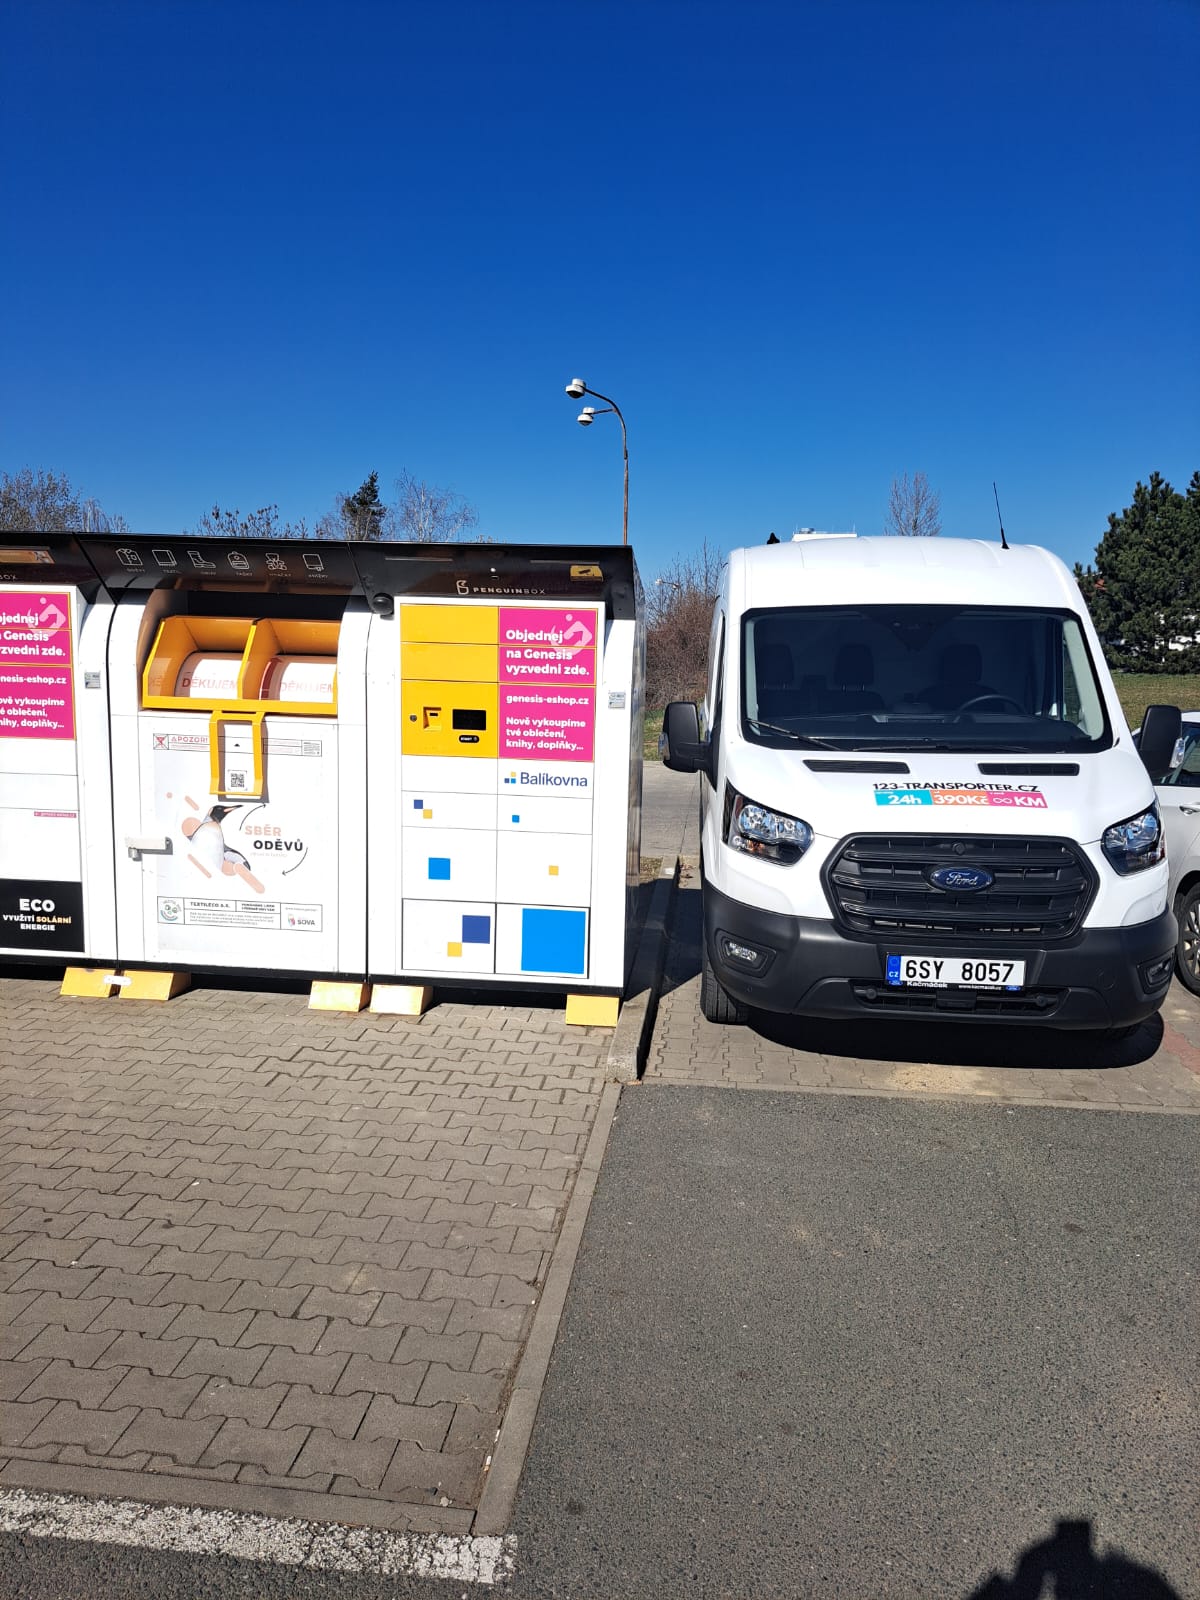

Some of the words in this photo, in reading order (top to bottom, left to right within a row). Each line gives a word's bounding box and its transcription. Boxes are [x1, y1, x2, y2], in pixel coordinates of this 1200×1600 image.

[473, 587, 546, 595] PENGUINBOX
[4, 630, 50, 643] Genesis
[506, 629, 563, 644] Objednej
[41, 645, 67, 657] zde.
[506, 650, 522, 659] na
[524, 649, 573, 661] Genesis
[506, 663, 562, 676] vyzvedni
[564, 664, 590, 676] zde.
[14, 696, 66, 708] vykoupíme
[506, 693, 589, 706] genesis-eshop.cz
[506, 716, 530, 726] Nově
[531, 718, 586, 730] vykoupíme
[506, 728, 521, 738] tvé
[523, 729, 567, 740] oblečení,
[506, 739, 536, 750] knihy,
[520, 771, 588, 787] Balíkovna
[872, 782, 1041, 793] 123-TRANSPORTER.CZ
[887, 794, 922, 805] 24h
[935, 794, 989, 805] 390Kč
[1013, 796, 1046, 808] KM
[245, 824, 281, 837] SBĚR
[253, 838, 304, 852] ODĚVŮ
[946, 871, 978, 886] Ford
[20, 898, 55, 913] ECO
[3, 913, 36, 922] VYUŽITÍ
[36, 915, 72, 924] SOLÁRNÍ
[20, 923, 56, 931] ENERGIE
[905, 959, 944, 980] 6SY
[961, 962, 1014, 983] 8057
